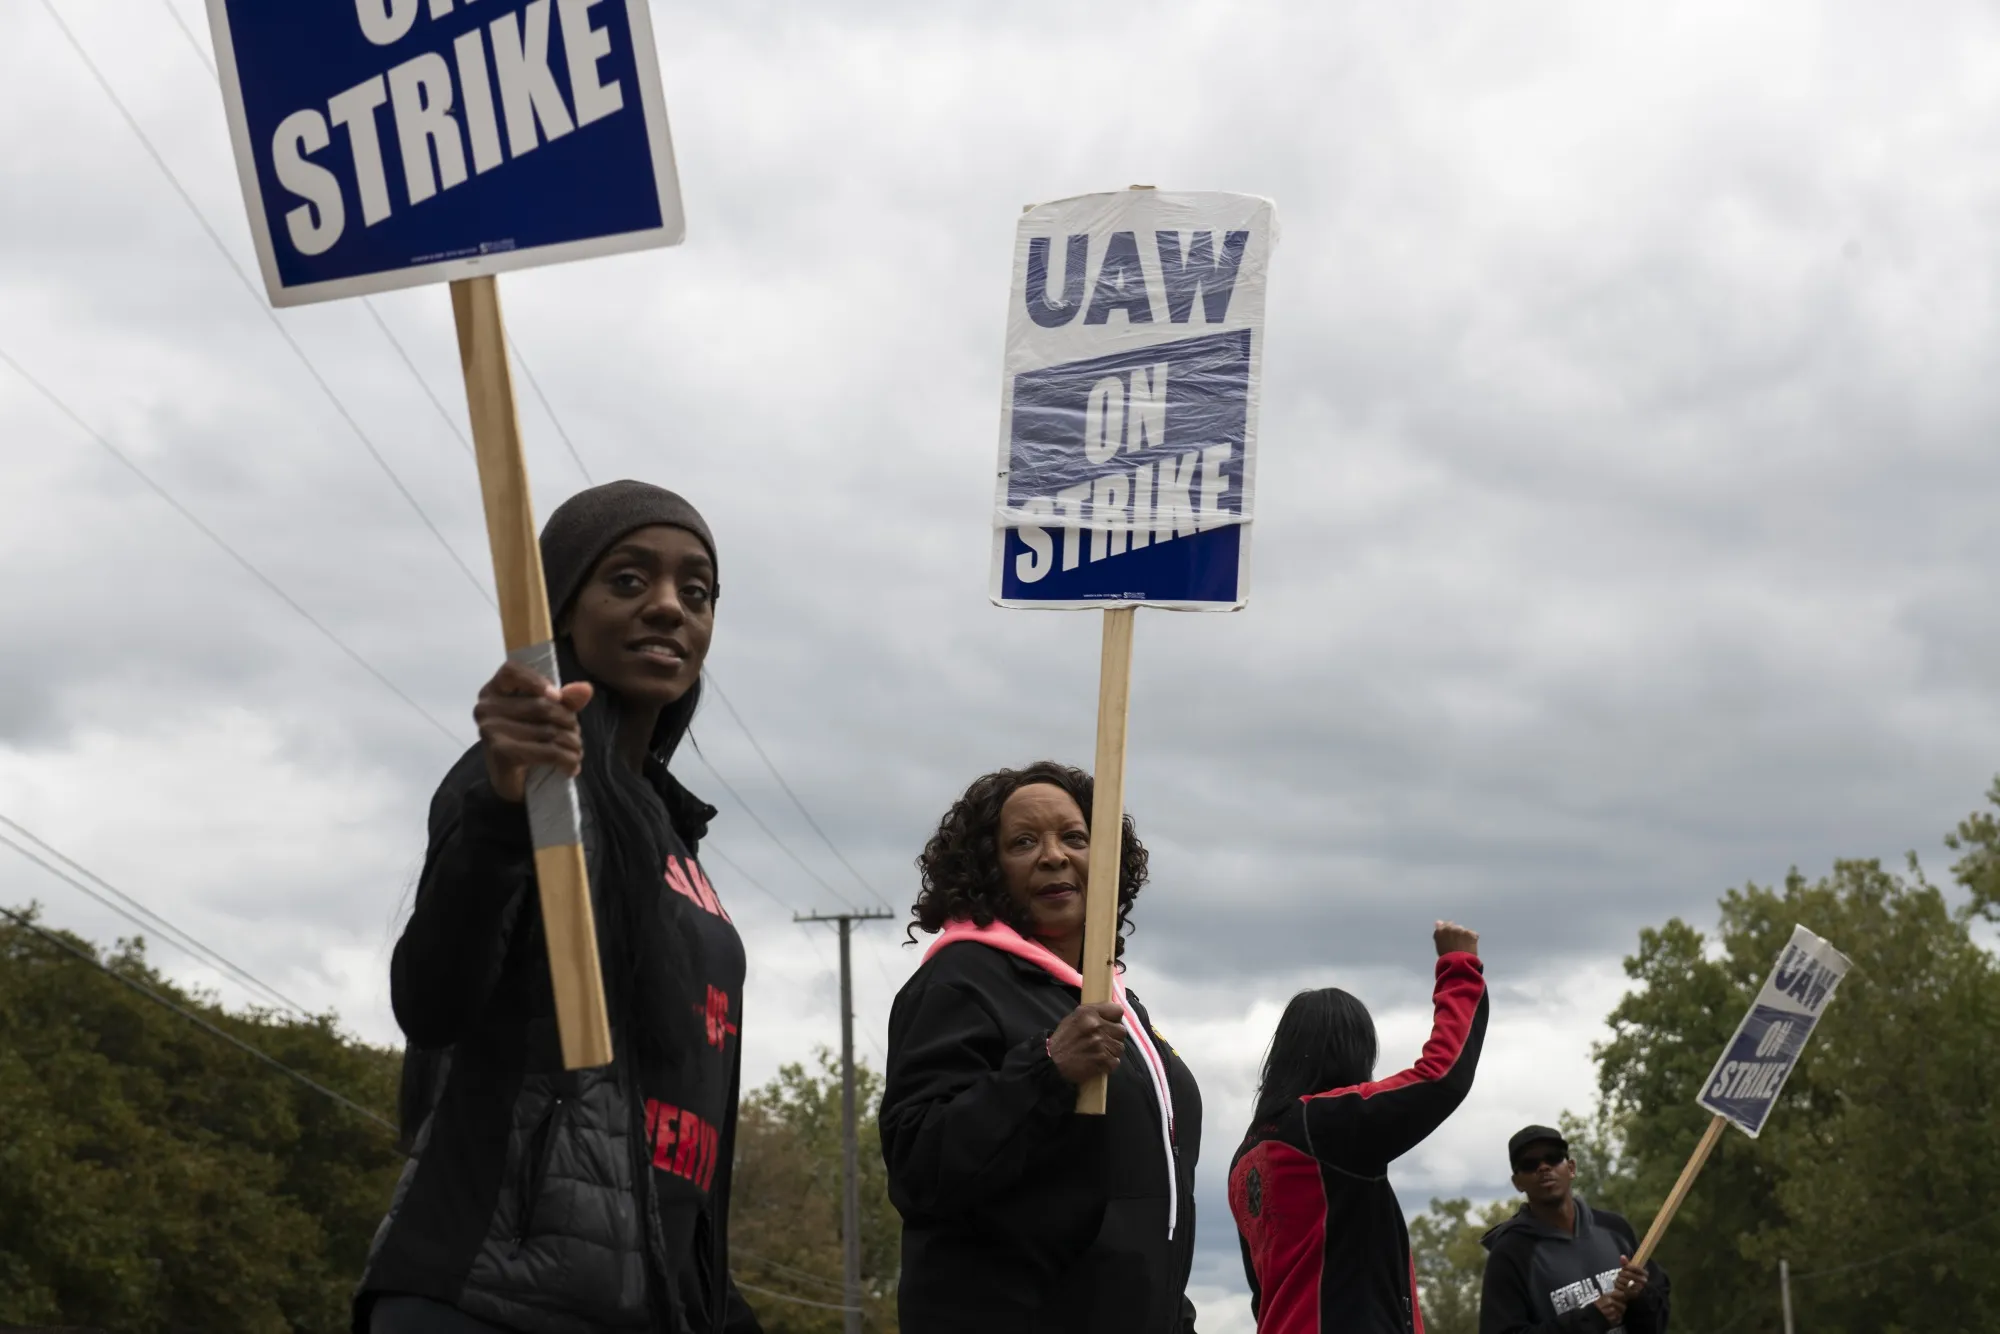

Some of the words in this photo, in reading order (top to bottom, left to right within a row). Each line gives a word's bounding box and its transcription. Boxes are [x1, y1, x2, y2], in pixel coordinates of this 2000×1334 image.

[272, 0, 624, 256] STRIKE
[1025, 230, 1250, 329] UAW
[1085, 361, 1168, 465] ON
[1015, 442, 1232, 584] STRIKE
[1775, 944, 1838, 1012] UAW
[1711, 1060, 1788, 1100] STRIKE
[1755, 1020, 1794, 1058] ON
